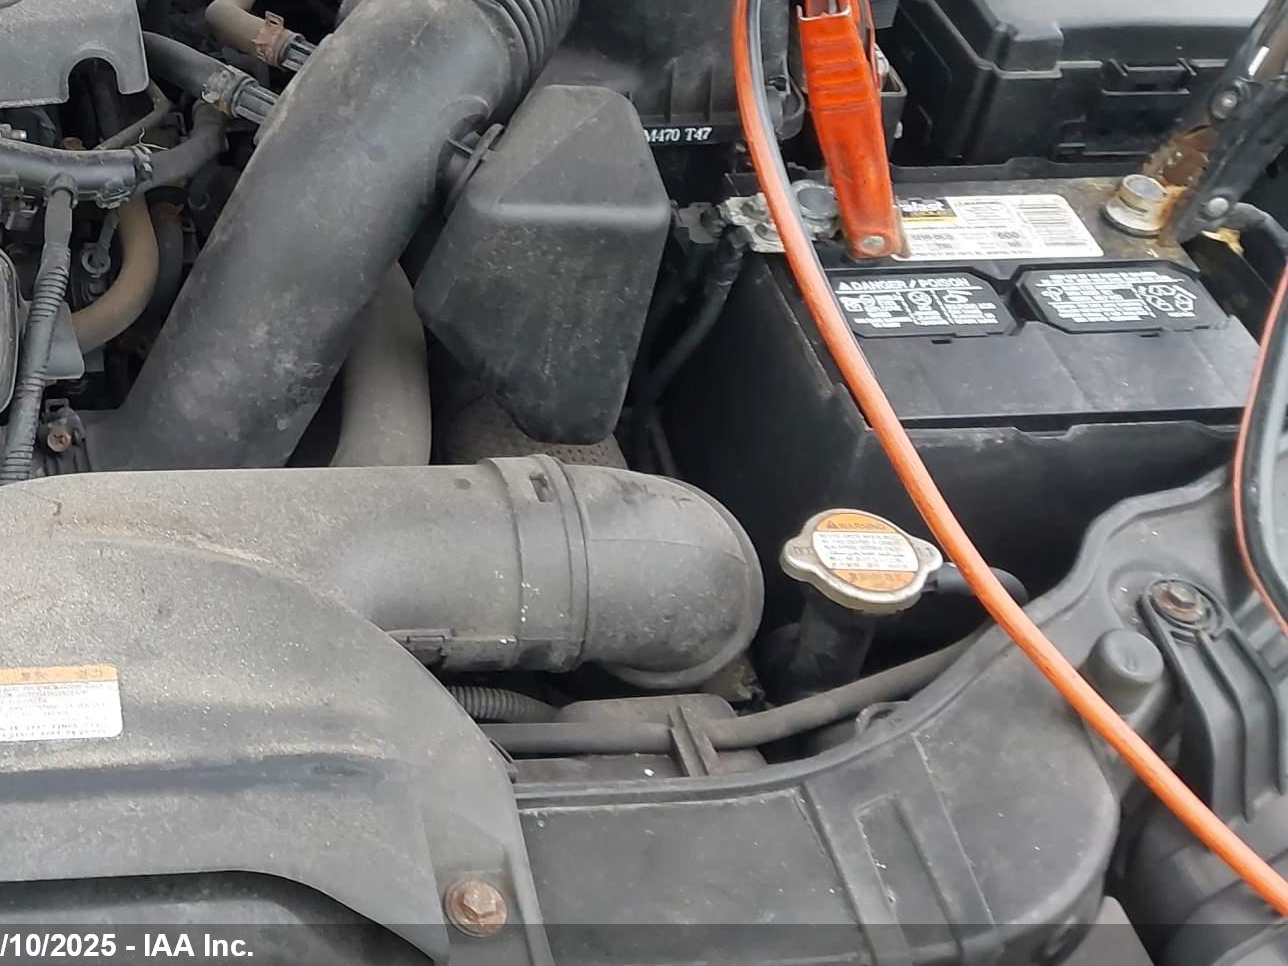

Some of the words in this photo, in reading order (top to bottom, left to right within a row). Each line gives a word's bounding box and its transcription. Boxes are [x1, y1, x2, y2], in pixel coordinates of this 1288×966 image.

[684, 126, 713, 141] T47
[851, 279, 907, 291] DANGER
[919, 277, 971, 288] POISON
